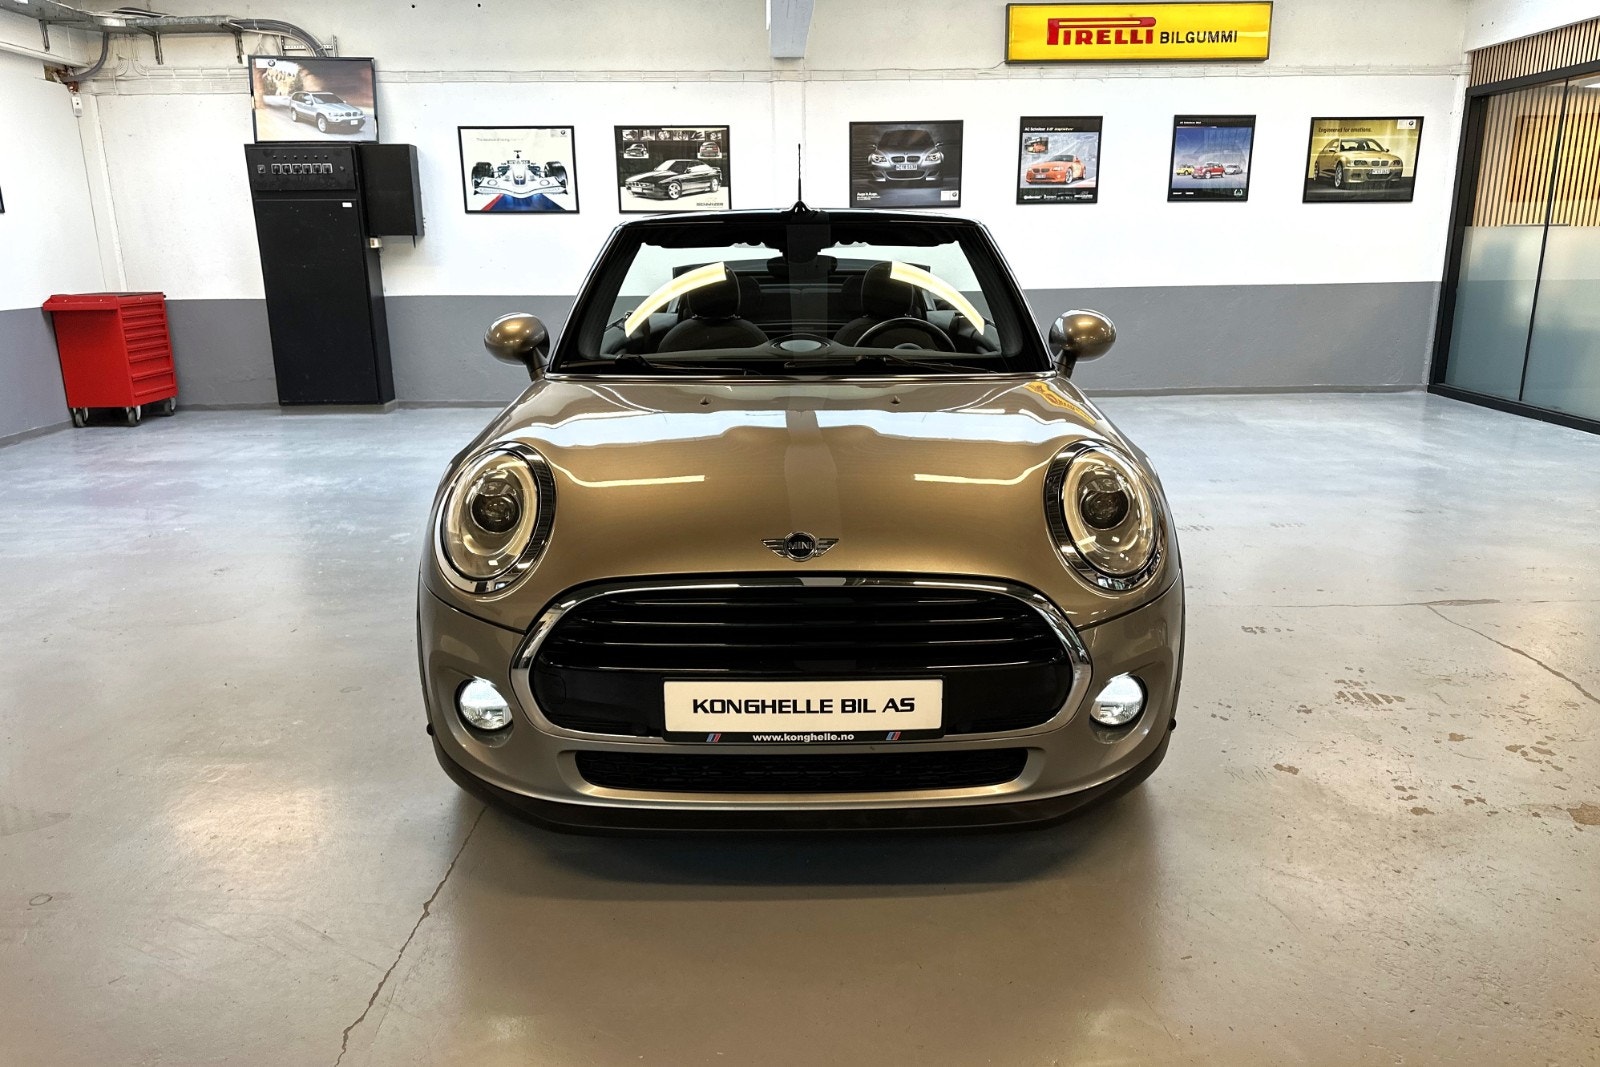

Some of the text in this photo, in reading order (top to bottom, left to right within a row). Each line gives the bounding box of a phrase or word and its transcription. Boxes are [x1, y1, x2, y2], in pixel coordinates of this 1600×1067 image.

[1047, 16, 1237, 45] PIRELLI BILGUMMI
[788, 541, 813, 549] MINI
[693, 698, 915, 714] KONGHELLE BIL AS
[752, 732, 855, 743] www.konghelle.no
